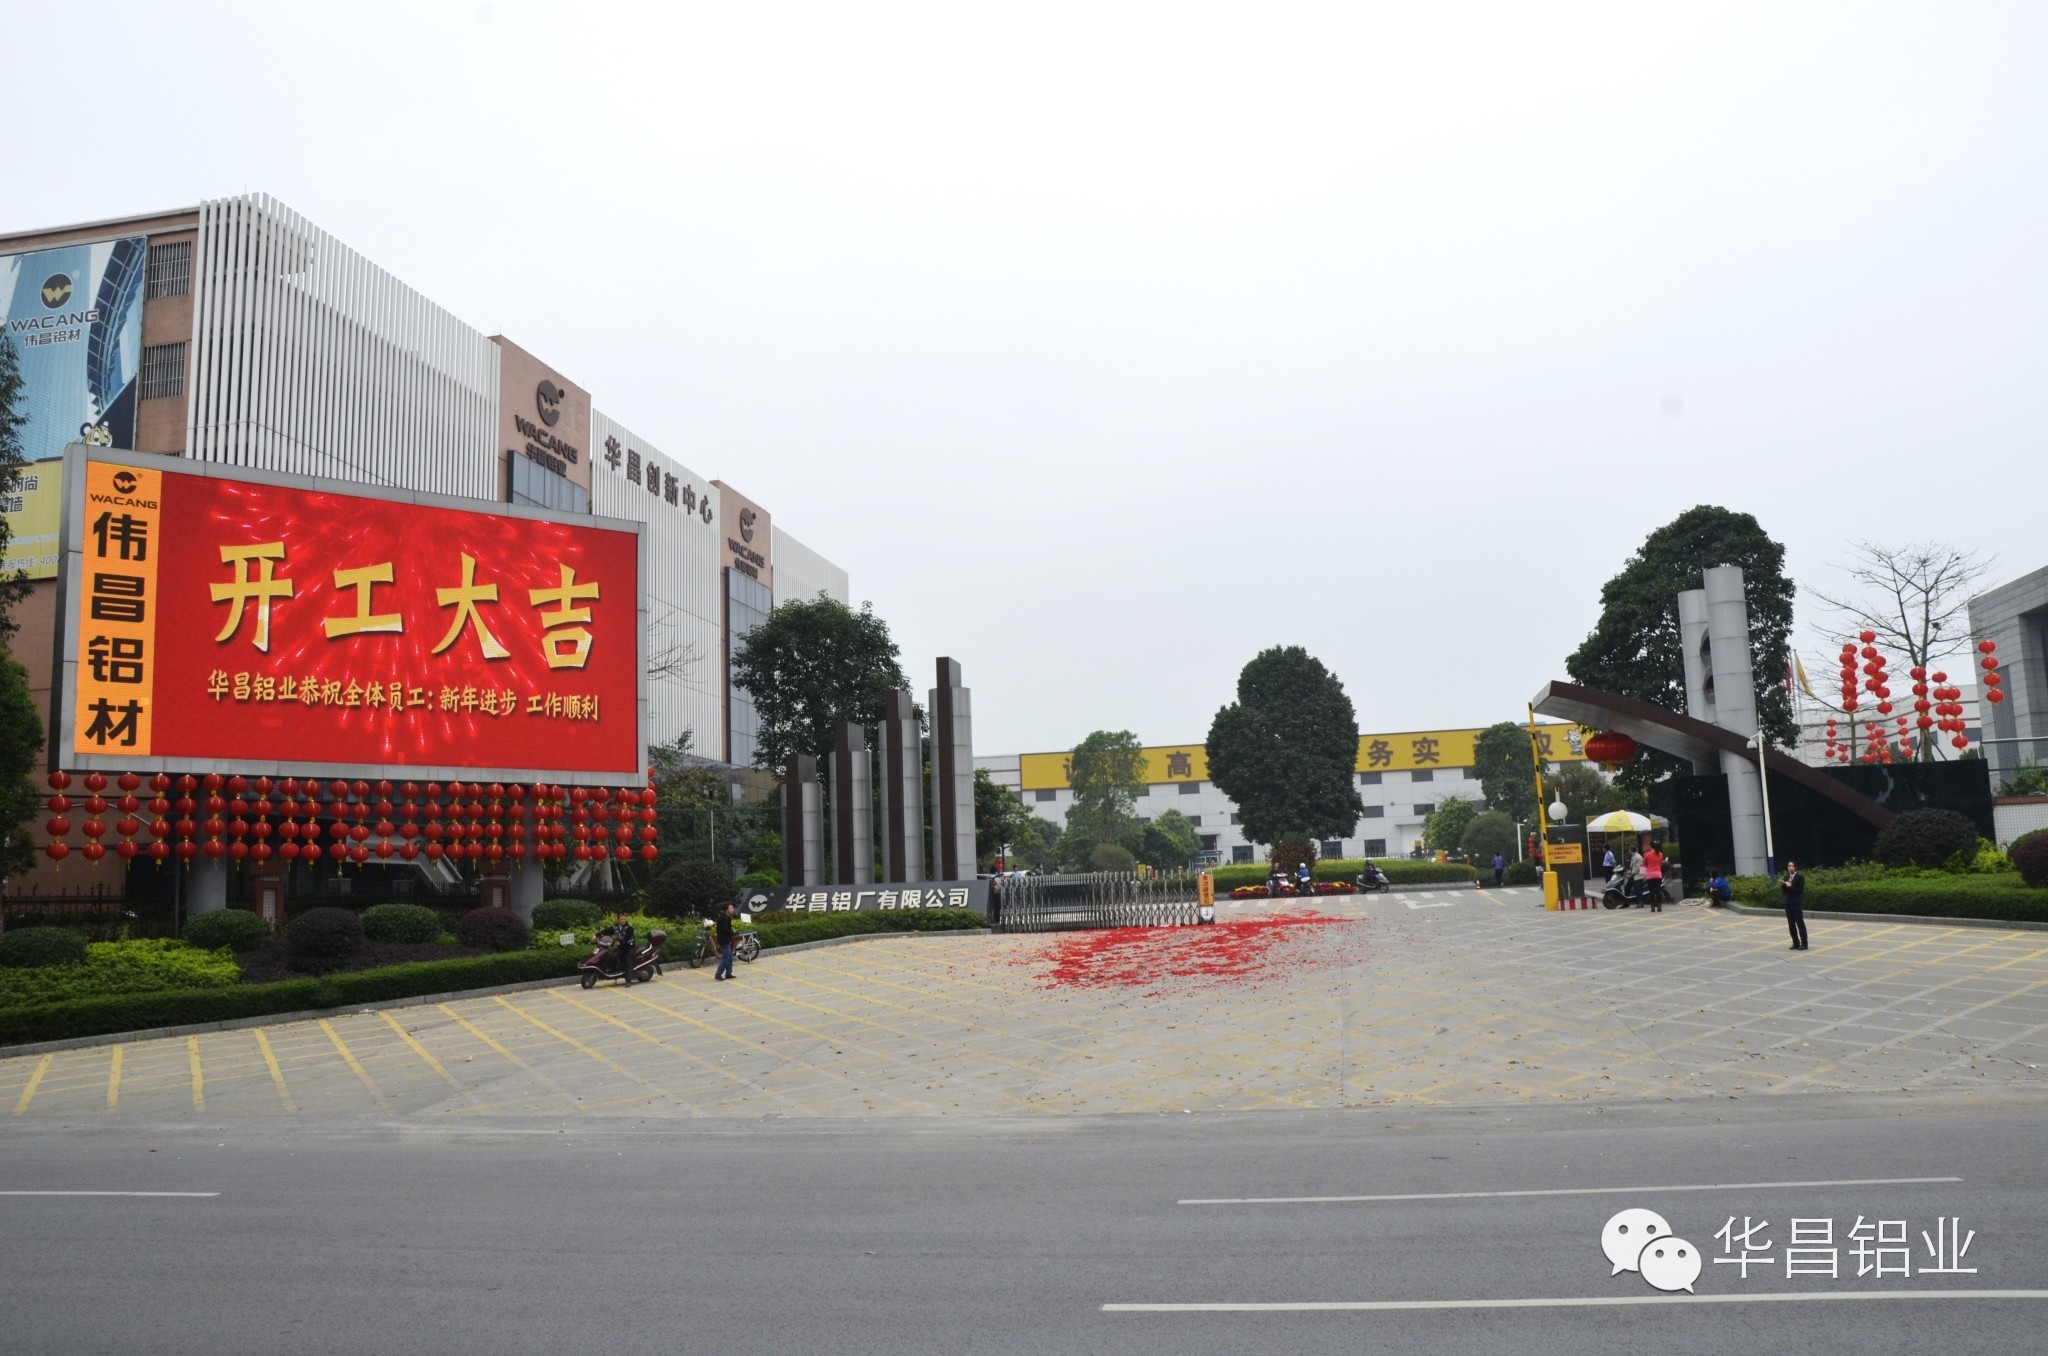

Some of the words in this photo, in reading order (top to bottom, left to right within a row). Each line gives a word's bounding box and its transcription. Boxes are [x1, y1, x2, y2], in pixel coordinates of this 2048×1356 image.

[11, 309, 100, 332] WACANG
[25, 329, 81, 347] 伟昌铝材
[515, 414, 578, 464] WACANG
[526, 442, 567, 478] 华昌铝业
[604, 434, 713, 524] 华昌创新中心
[90, 493, 158, 509] WACANG
[728, 537, 765, 568] WACANG
[209, 541, 599, 668] 开工大吉
[85, 511, 148, 746] 伟昌铝材
[526, 692, 599, 721] 工作顺利
[1367, 737, 1440, 768] 务实
[785, 887, 969, 912] 华昌铝厂有限公司
